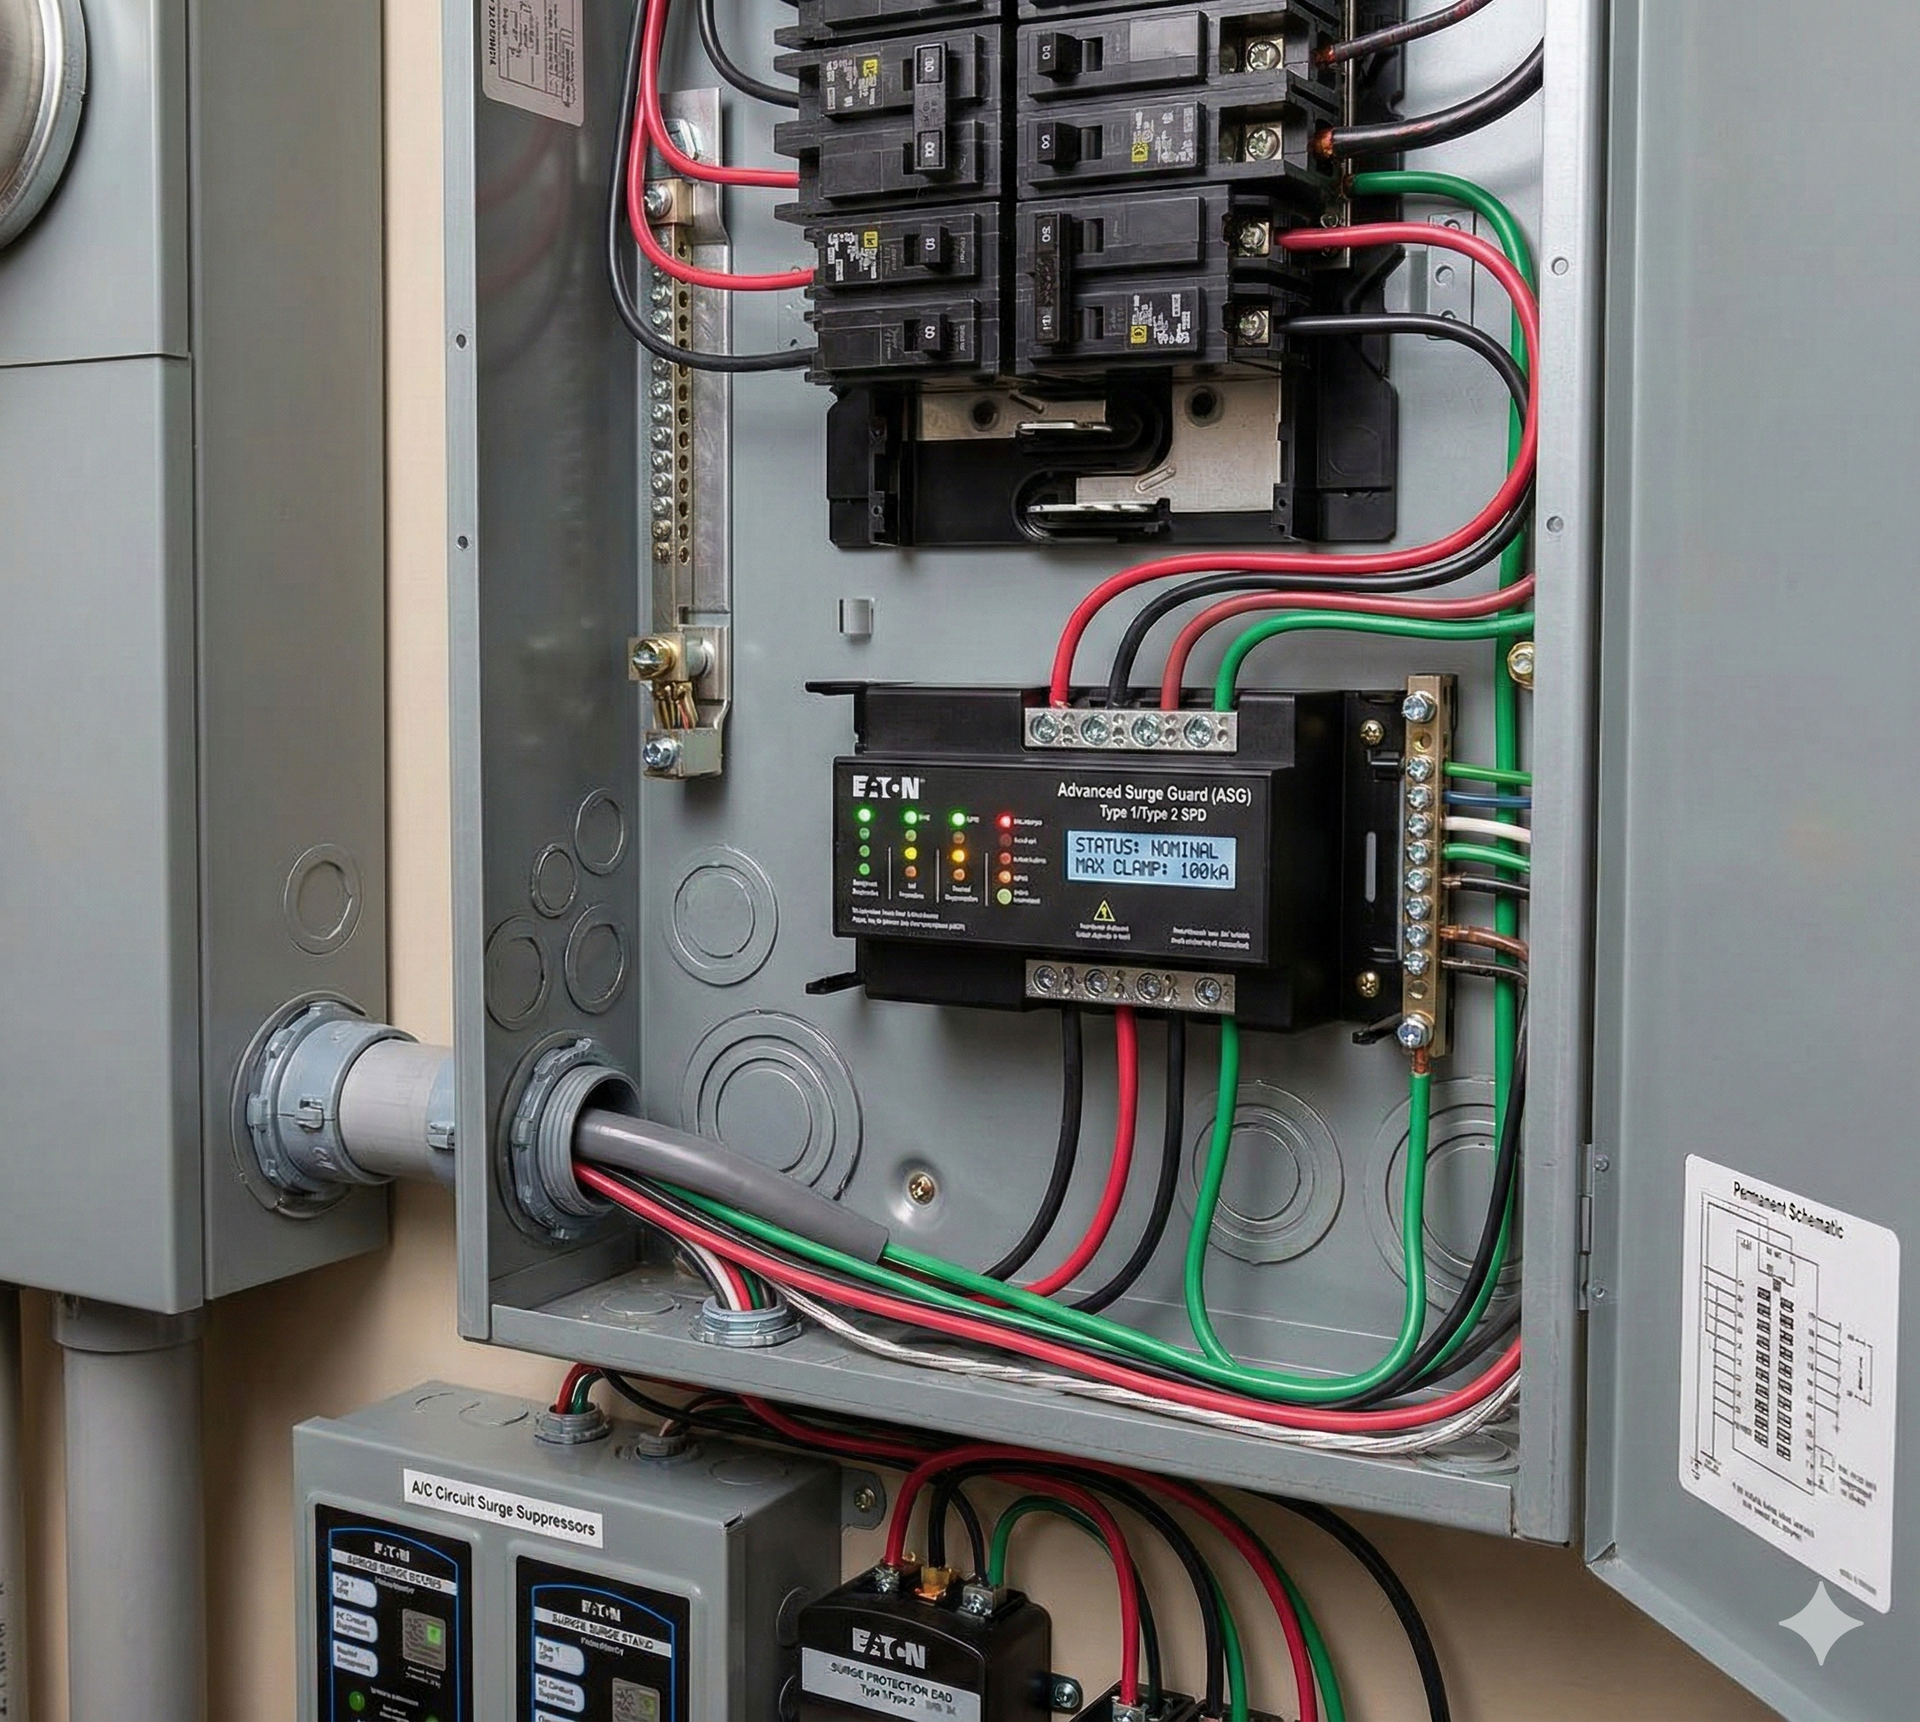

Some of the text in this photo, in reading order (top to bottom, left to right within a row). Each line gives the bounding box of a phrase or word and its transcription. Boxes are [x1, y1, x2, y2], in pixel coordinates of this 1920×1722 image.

[852, 775, 920, 799] EATON
[1057, 782, 1252, 806] Advanced Surge Guard (ASG)
[1099, 804, 1208, 823] Type 1/Type 2 SPD
[1076, 836, 1219, 859] STATUS: NOMINAL
[1076, 858, 1229, 880] MAX CLAMP: 100kA
[412, 1480, 596, 1536] A/C Circuit Surge Suppressors
[852, 1627, 926, 1669] EATON
